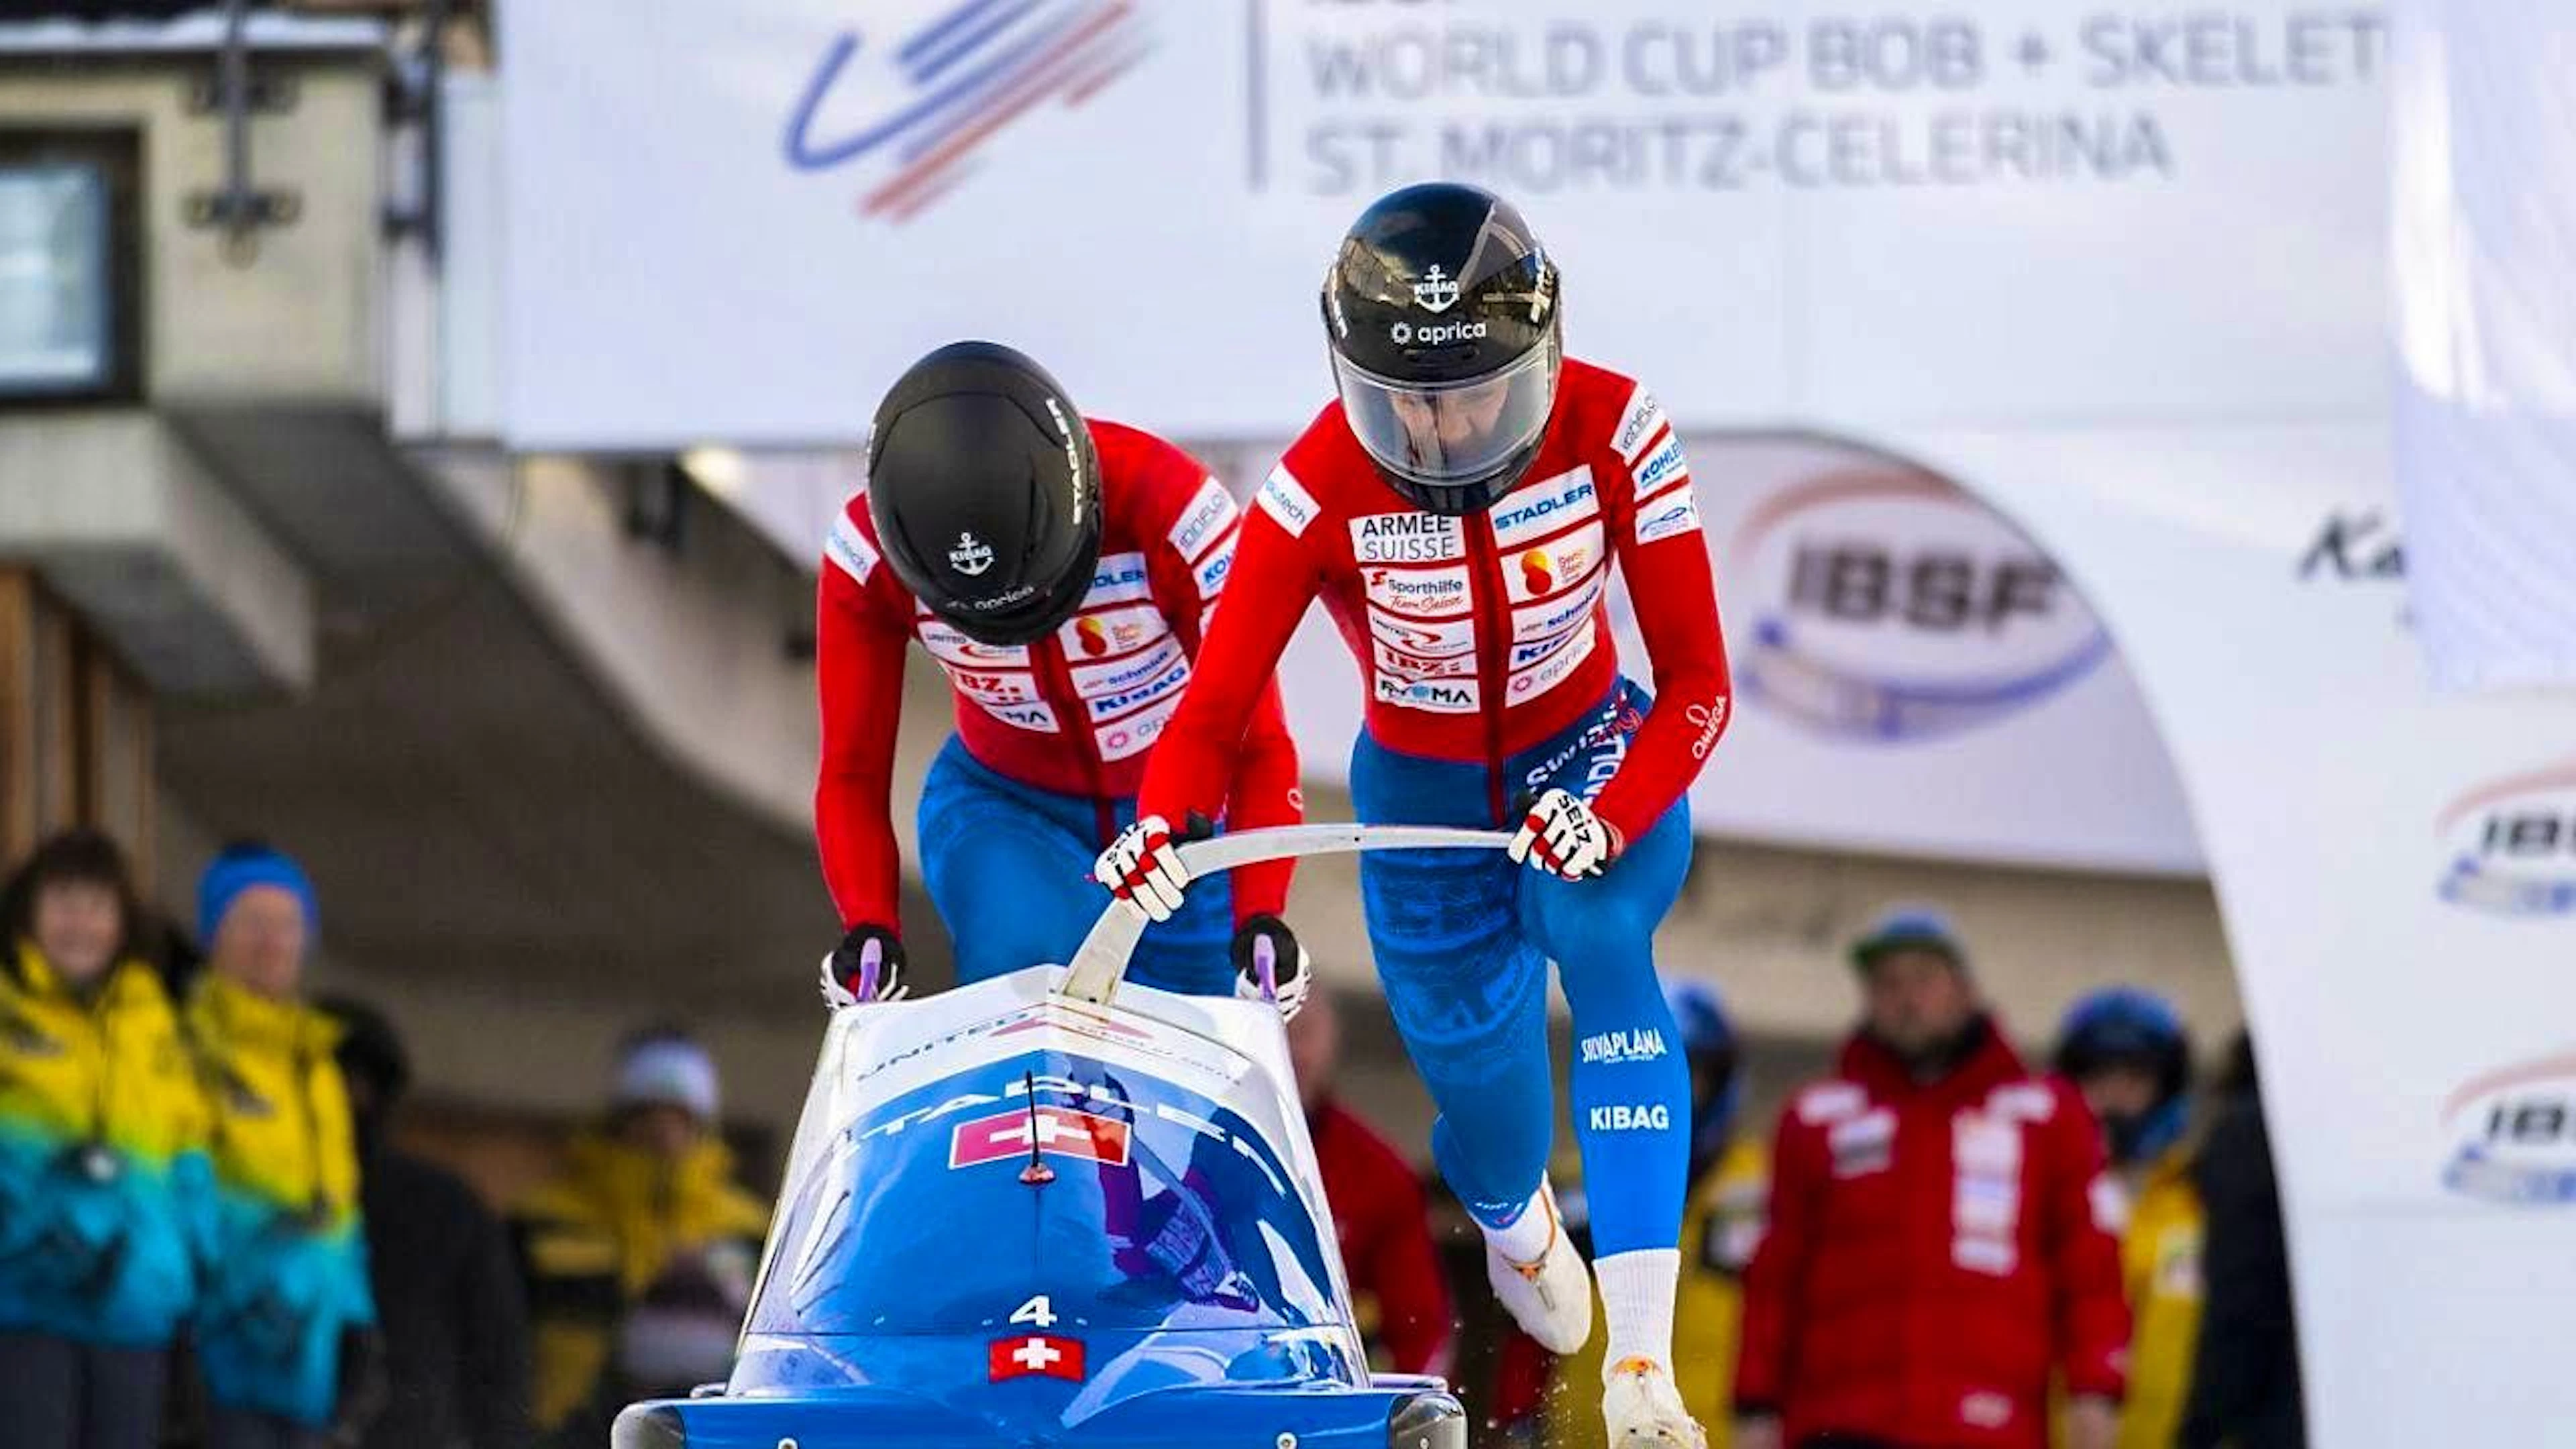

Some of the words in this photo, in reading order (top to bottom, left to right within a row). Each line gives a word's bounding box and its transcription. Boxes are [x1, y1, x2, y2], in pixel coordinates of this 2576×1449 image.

[1305, 20, 1606, 101] WORLD
[1622, 19, 1790, 97] CUP
[1806, 15, 1986, 91] BOB
[2078, 11, 2385, 89] SKELET
[1417, 321, 1487, 345] aprica
[1495, 482, 1593, 530] STADLER
[1364, 535, 1455, 561] SUISSE
[1094, 570, 1145, 588] DLER
[1388, 579, 1463, 595] Sporthilfe
[1784, 541, 2059, 636] IBSF
[1691, 695, 1728, 760] OMEGA
[1557, 794, 1593, 845] SEIZ
[844, 1075, 1285, 1199] TADLER
[1590, 1104, 1670, 1131] KIBAG
[1008, 1293, 1059, 1328] 4
